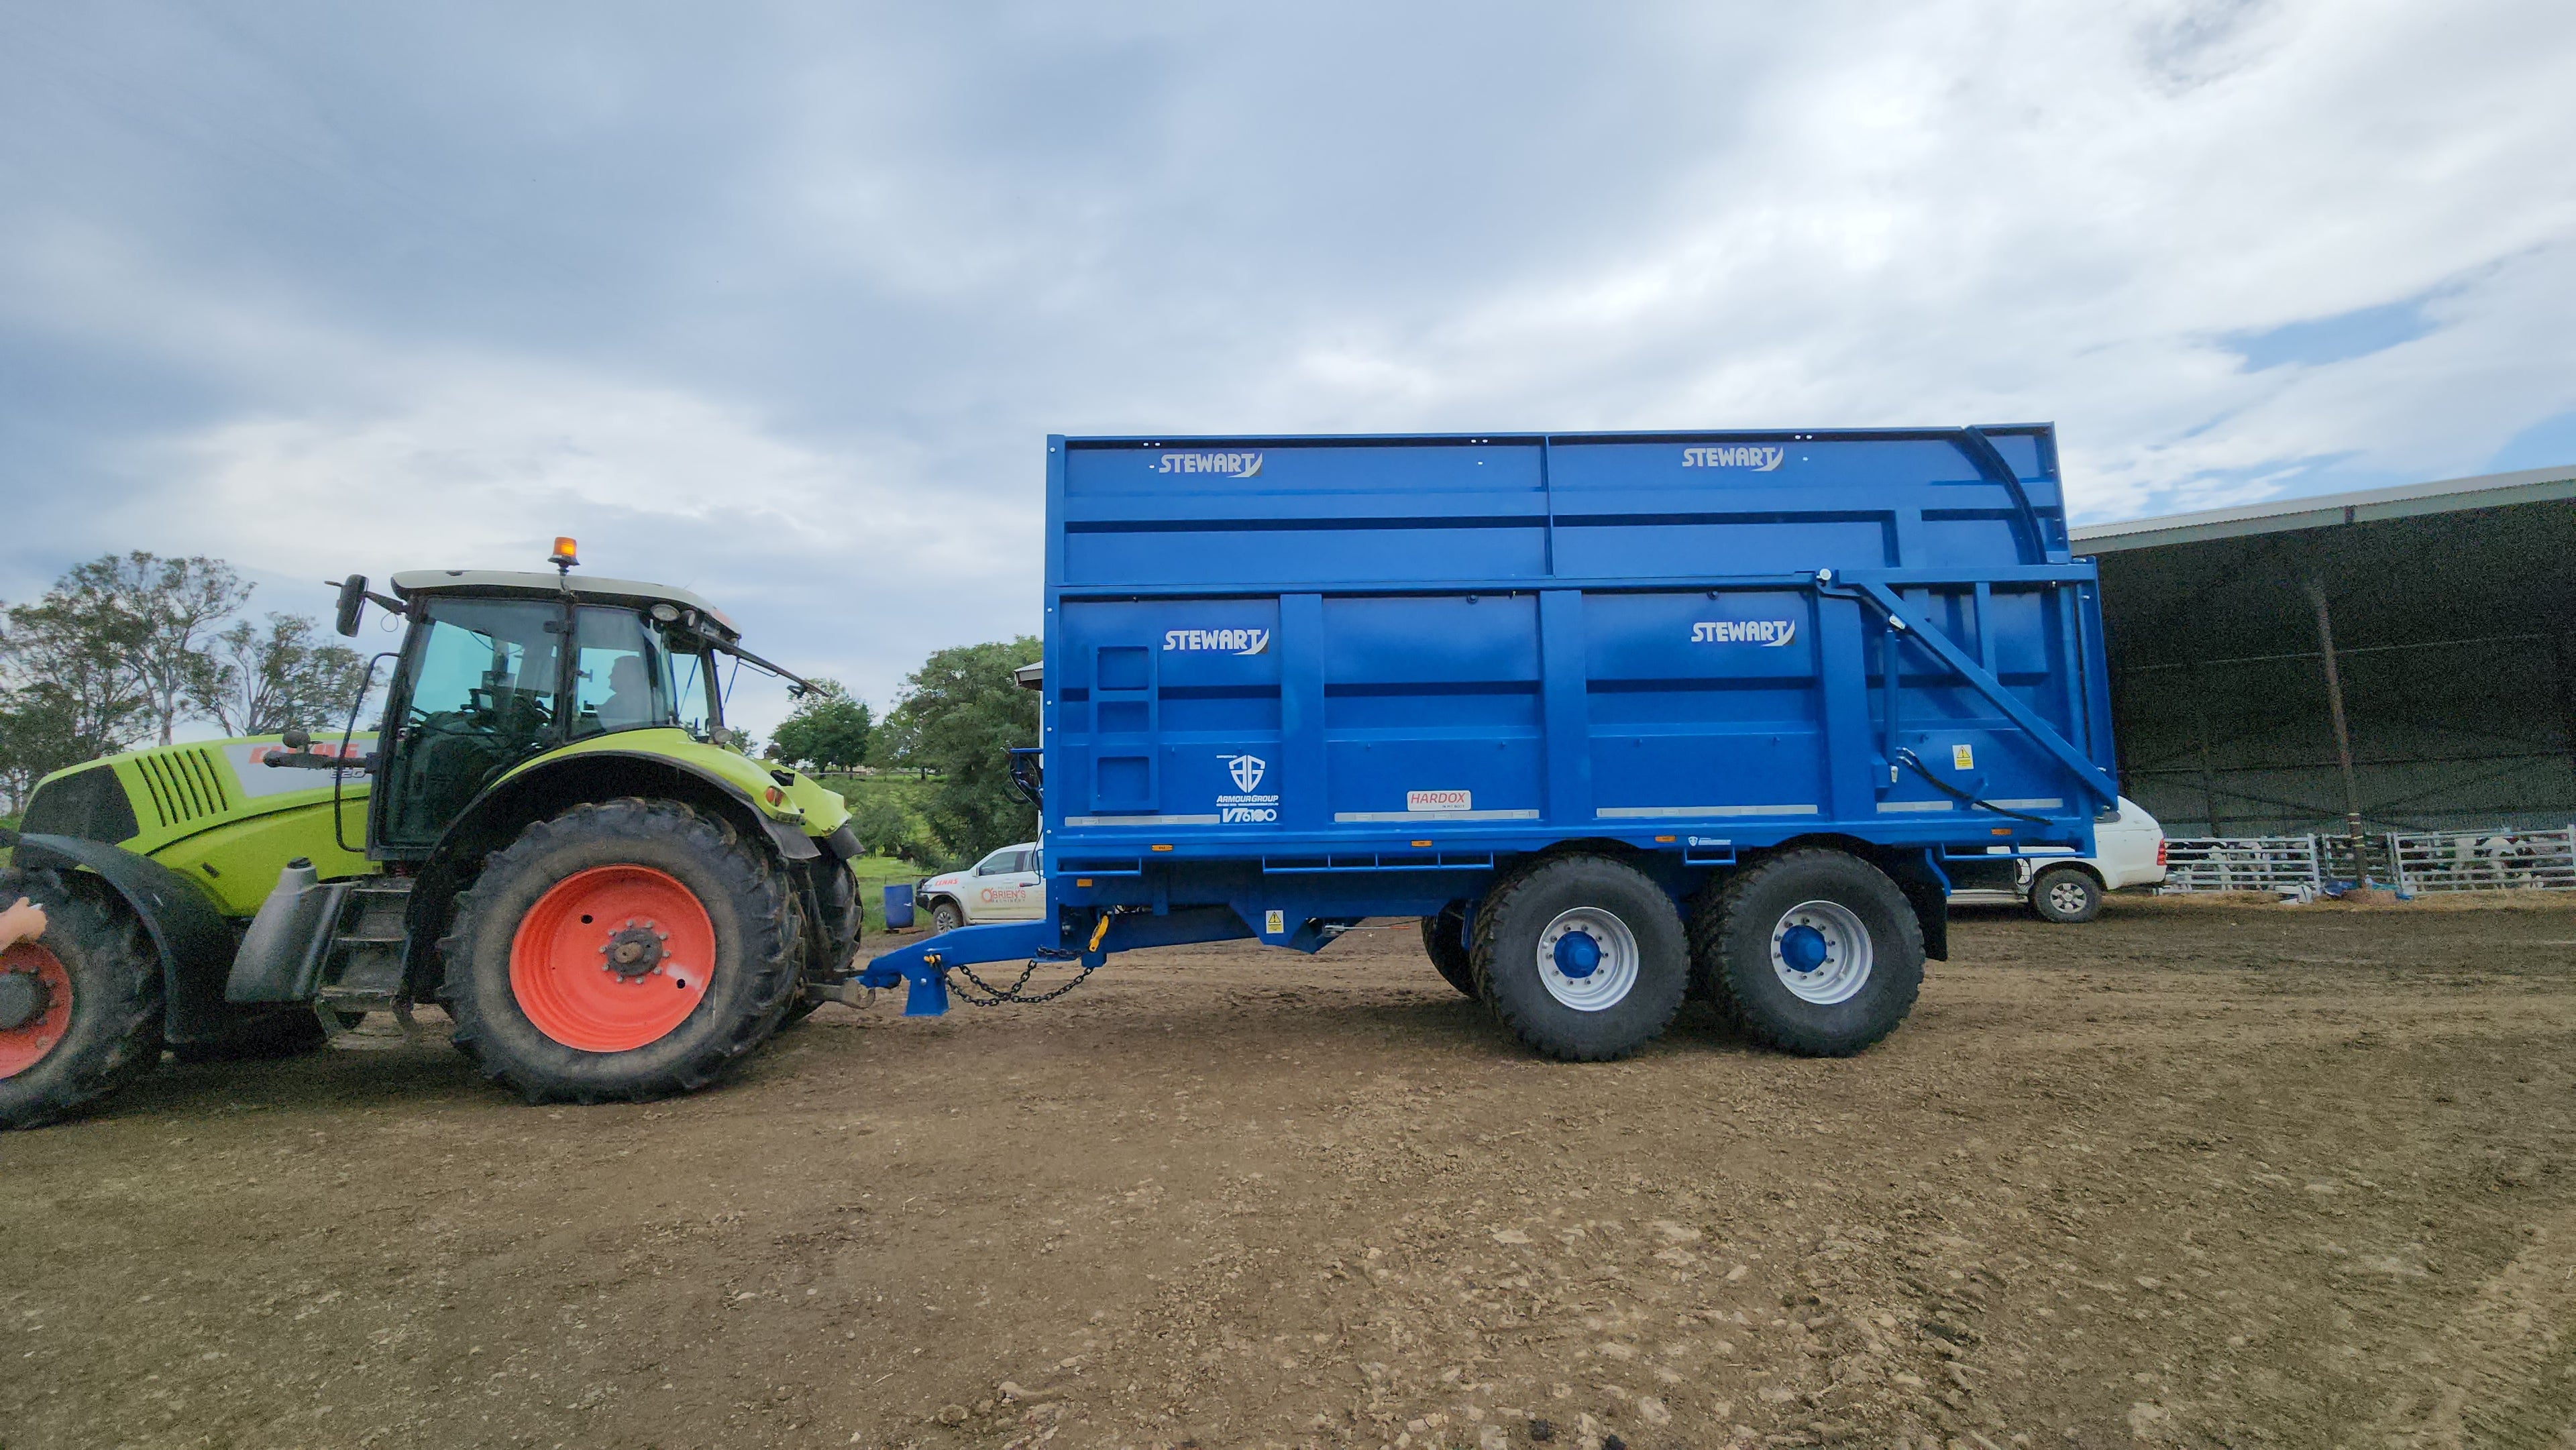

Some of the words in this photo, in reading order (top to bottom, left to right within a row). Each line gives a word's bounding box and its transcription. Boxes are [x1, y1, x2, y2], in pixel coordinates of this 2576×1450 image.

[1159, 452, 1263, 478] STEWART
[1682, 446, 1784, 471] STEWART
[1163, 628, 1269, 655] STEWART
[1690, 619, 1796, 647] STEWART
[249, 743, 359, 764] CAS
[1411, 793, 1466, 804] HARDOX
